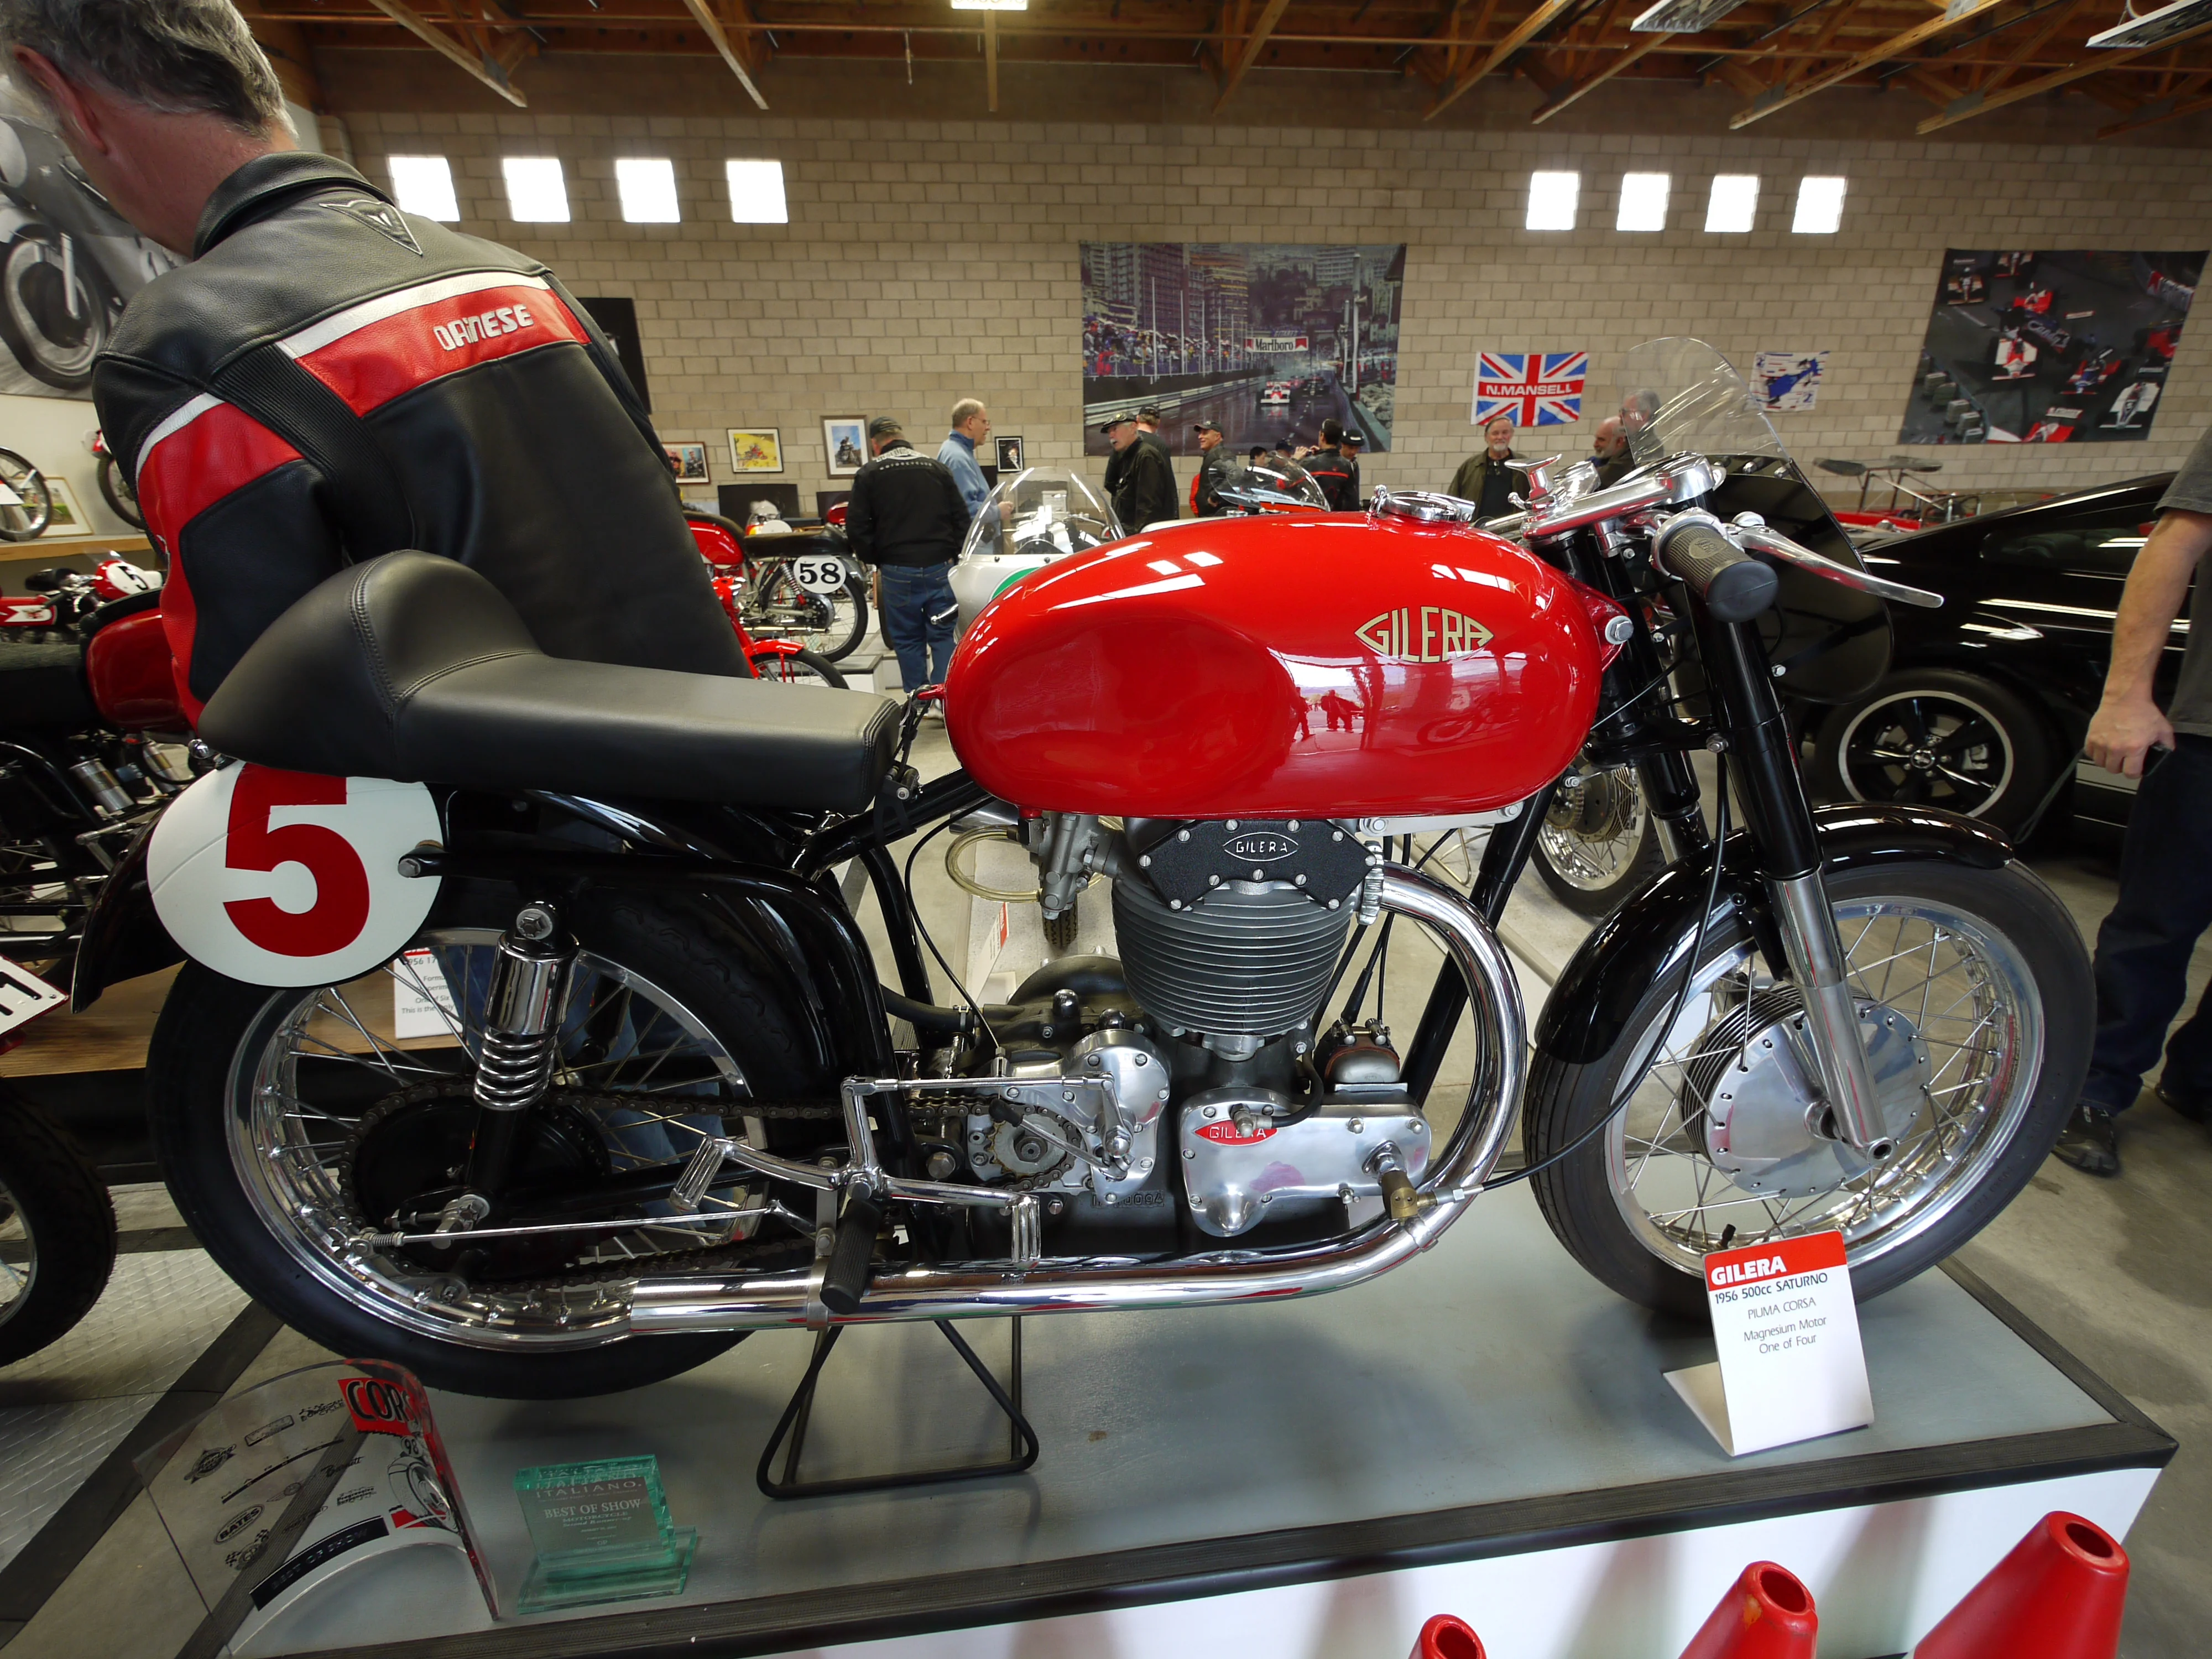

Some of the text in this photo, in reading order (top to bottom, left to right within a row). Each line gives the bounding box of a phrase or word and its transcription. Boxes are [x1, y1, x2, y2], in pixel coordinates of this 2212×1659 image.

[1255, 338, 1294, 351] Marlboro
[1486, 384, 1572, 395] N.MANSELL
[800, 562, 841, 584] 58
[1354, 606, 1494, 663] GILERA
[1236, 841, 1288, 853] GILERA
[222, 762, 370, 957] 5
[409, 957, 424, 966] 956
[1209, 1126, 1267, 1139] GILEA
[1711, 1256, 1787, 1285] GILERA
[1715, 1272, 1828, 1305] 1956 500cc SATURNO
[1747, 1297, 1817, 1319] PIUMA CORSA
[1744, 1317, 1827, 1342] Magnesium Motor
[1759, 1334, 1817, 1354] One of Four
[405, 1438, 419, 1455] 98
[544, 1499, 641, 1519] BEST OF SHOW
[563, 1511, 628, 1523] MOTORCYCLE
[220, 1507, 260, 1540] BATES
